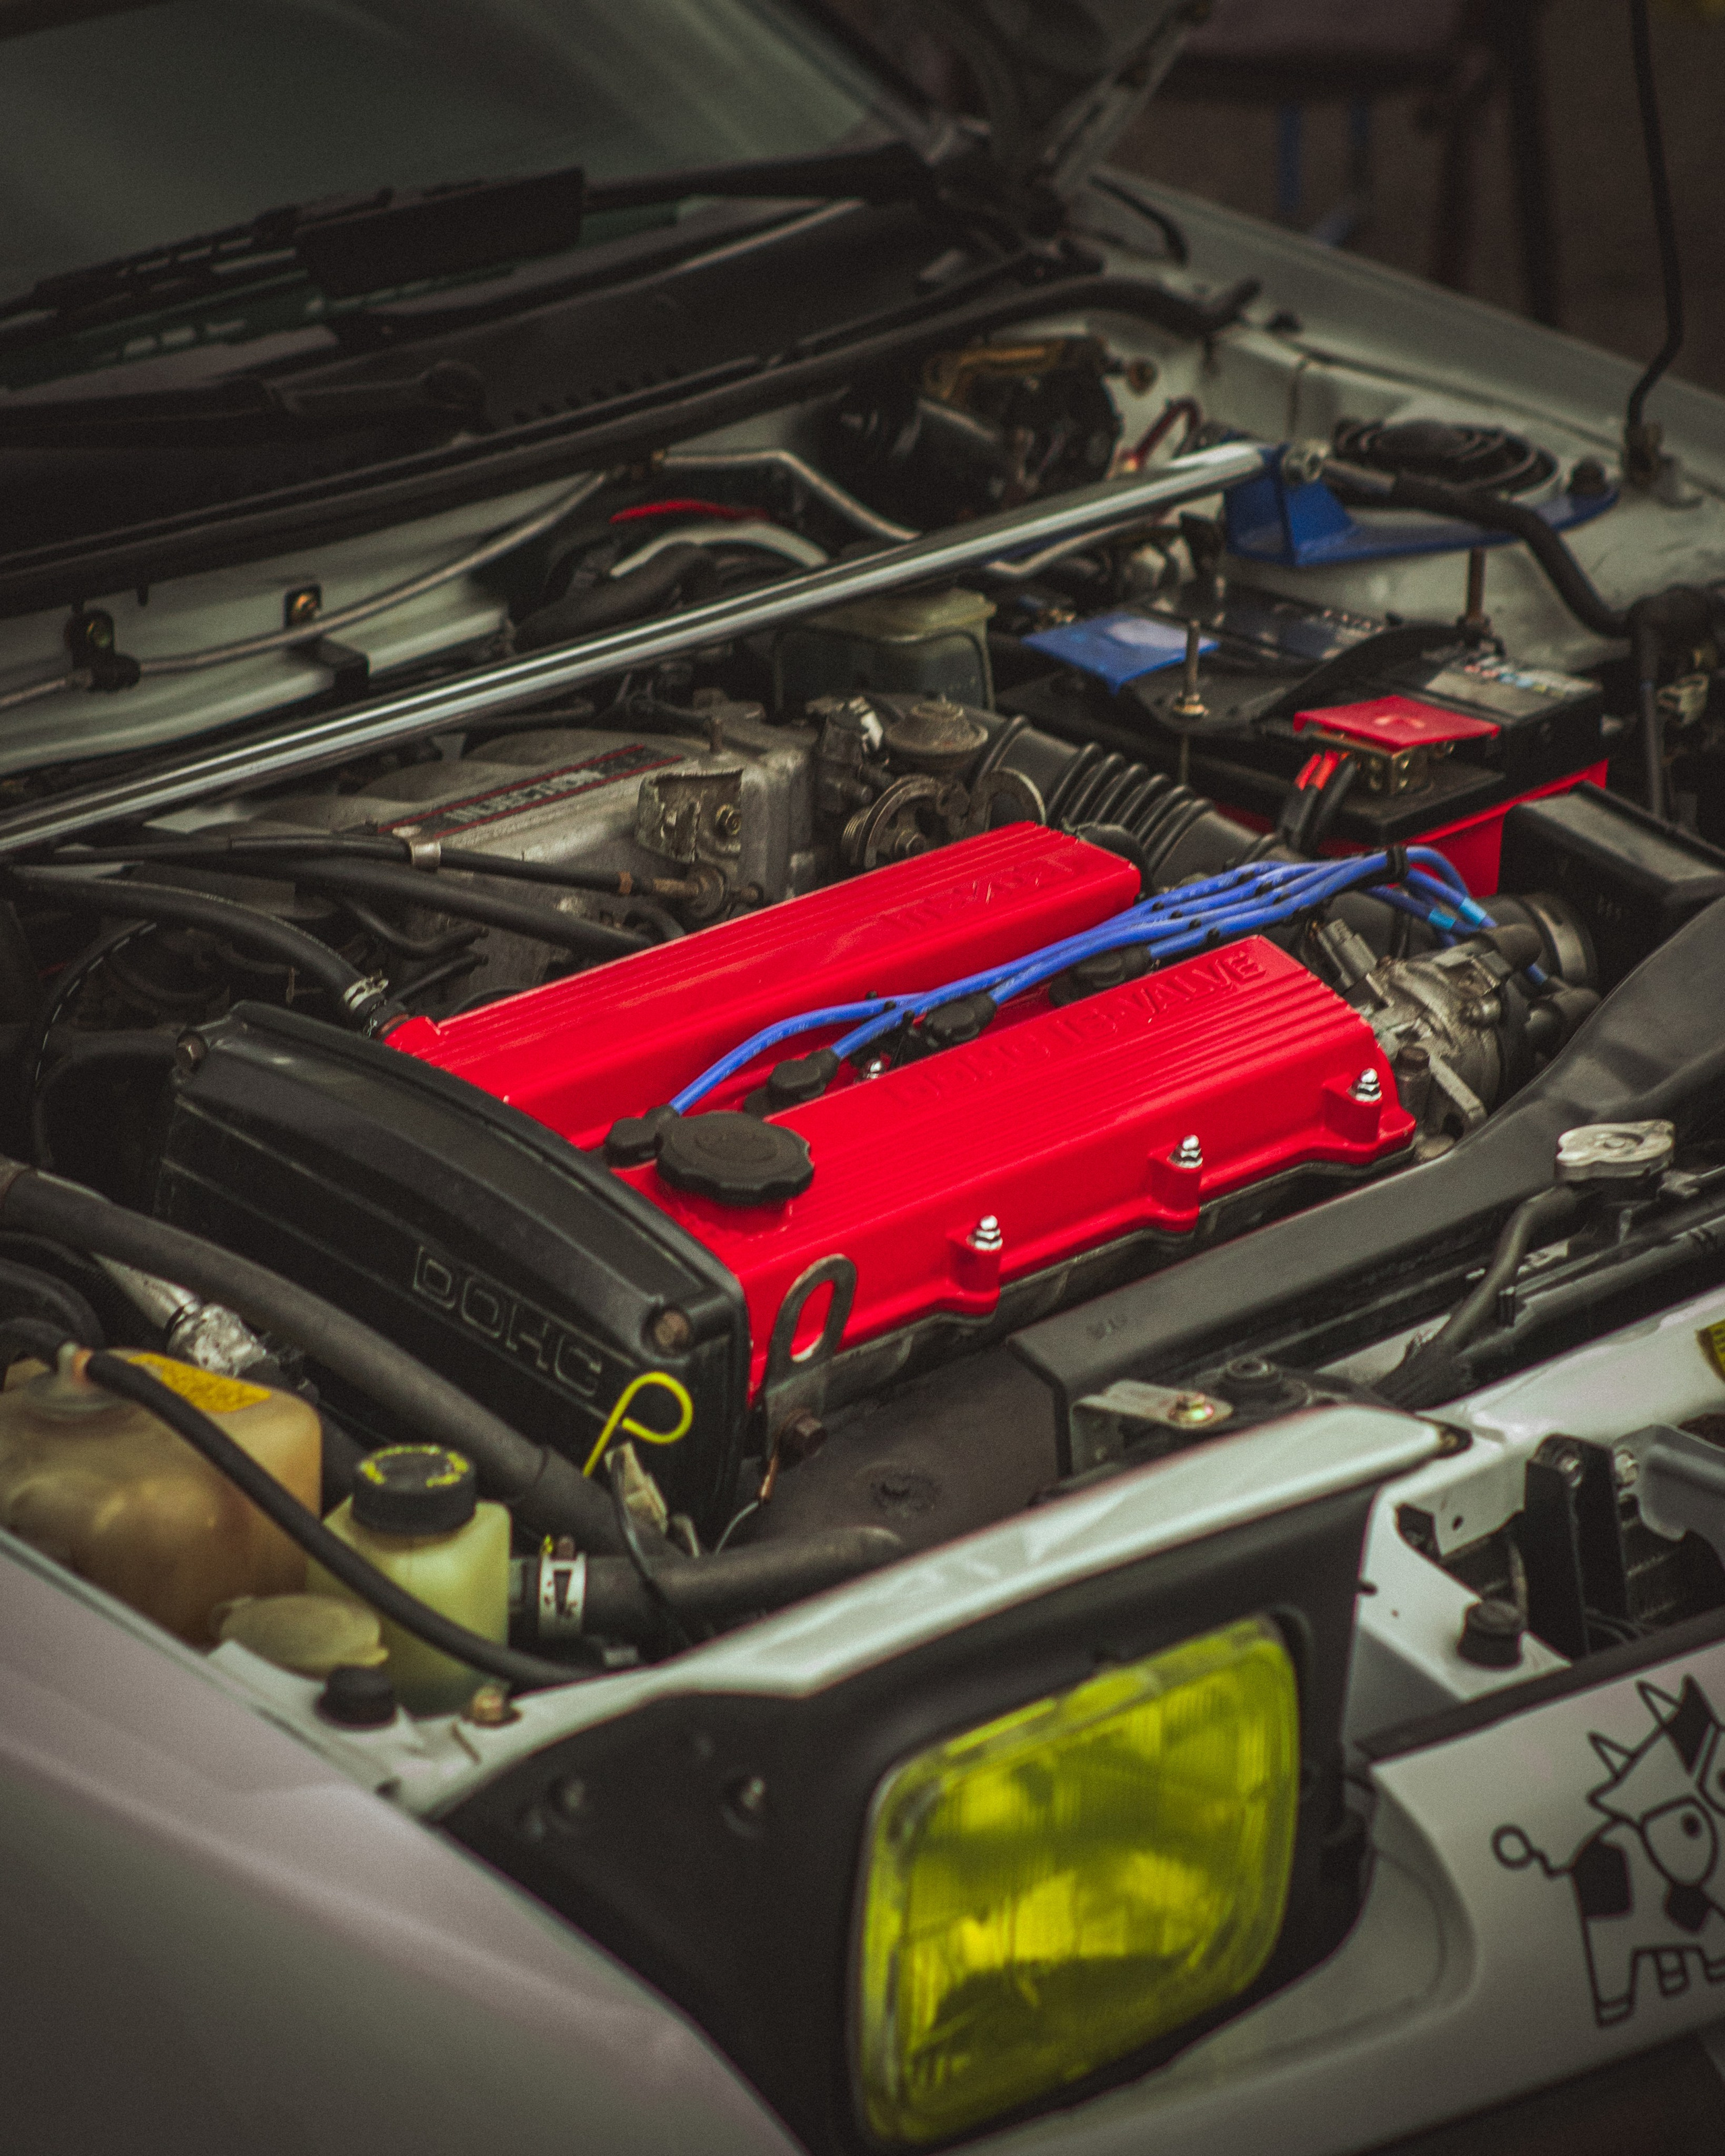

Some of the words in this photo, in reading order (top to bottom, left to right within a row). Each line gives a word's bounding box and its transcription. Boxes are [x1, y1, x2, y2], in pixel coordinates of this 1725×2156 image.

[883, 1034, 1051, 1109] DOHC
[1047, 949, 1267, 1047] 16-VALVE
[412, 1245, 602, 1397] DOHC
